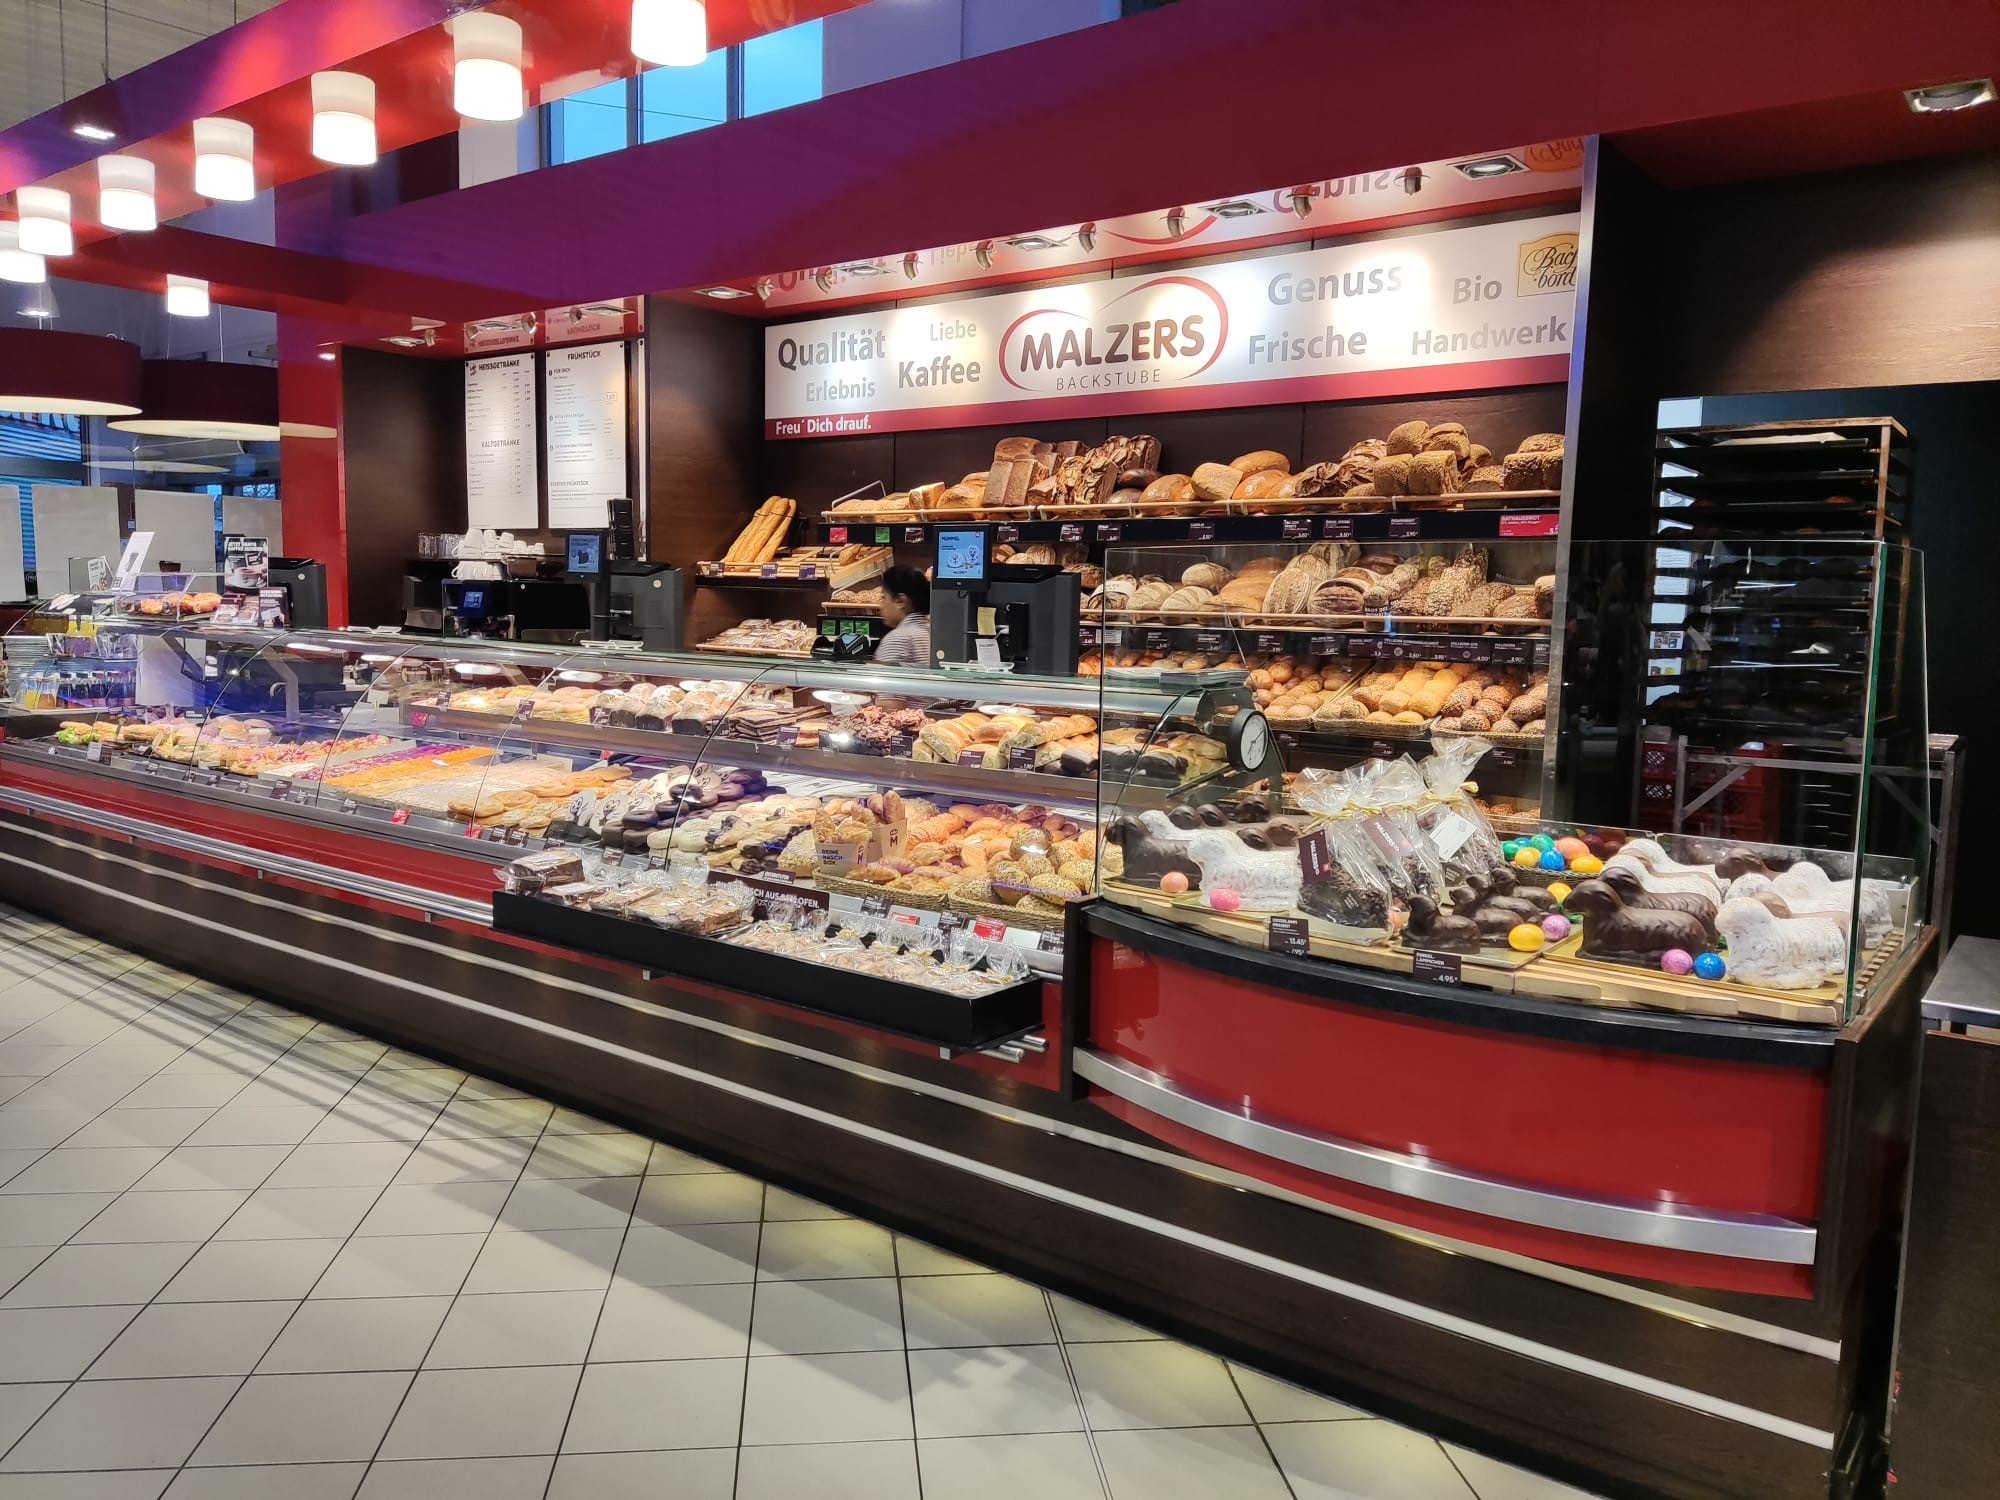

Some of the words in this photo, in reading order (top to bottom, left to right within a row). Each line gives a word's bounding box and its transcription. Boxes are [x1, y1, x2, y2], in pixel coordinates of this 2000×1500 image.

[1268, 266, 1403, 305] Genuss
[1453, 275, 1502, 304] Bio
[930, 320, 977, 342] Liebe
[1021, 315, 1205, 372] MALZERS
[1249, 326, 1368, 365] Frische
[1411, 316, 1567, 355] Handwerk
[778, 329, 886, 371] Qualität
[899, 356, 981, 388] Kaffee
[1056, 369, 1161, 391] BACKSTUBE
[806, 377, 876, 402] Erlebnis
[807, 417, 832, 434] Dich
[835, 415, 872, 432] drauf.
[765, 890, 779, 901] AUS
